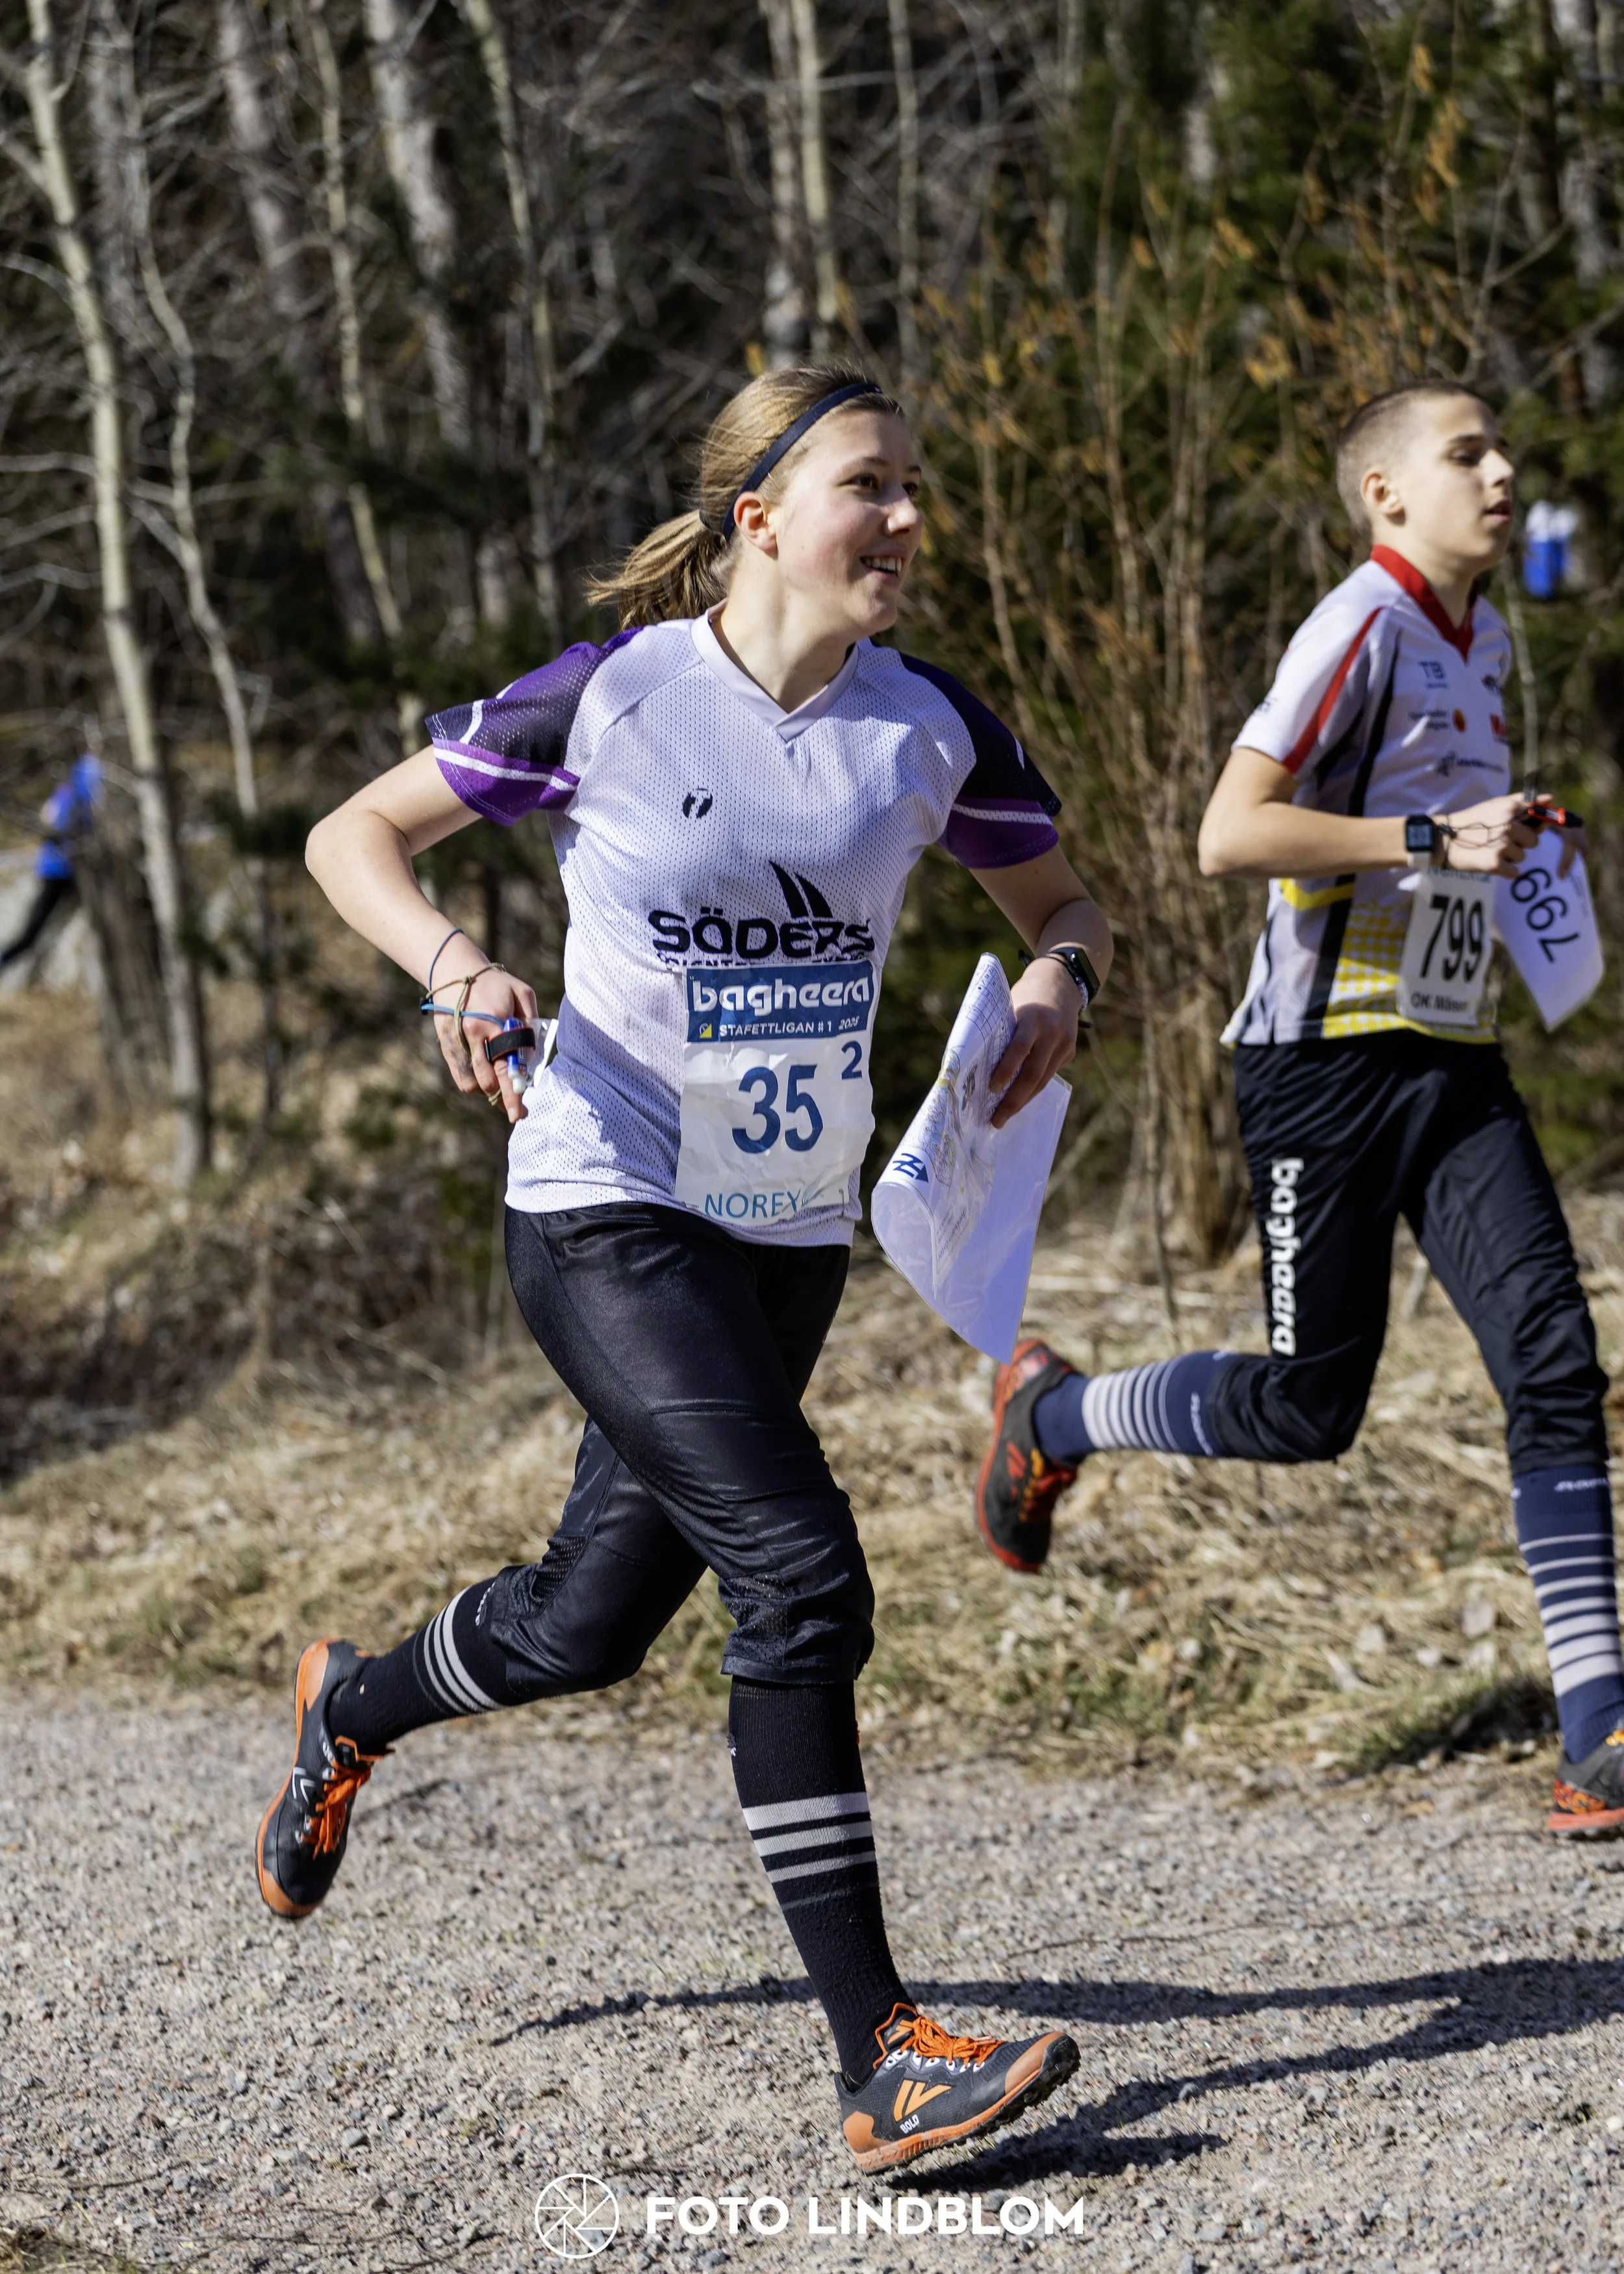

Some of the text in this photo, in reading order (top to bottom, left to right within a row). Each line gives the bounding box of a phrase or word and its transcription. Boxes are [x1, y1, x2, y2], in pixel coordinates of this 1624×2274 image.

[648, 906, 875, 959] SÖDERS
[1420, 894, 1484, 982] 799
[1510, 867, 1580, 963] 799
[690, 977, 869, 1016] bagheera
[719, 1022, 814, 1037] STAFETTLIGAN
[841, 1040, 863, 1080] 2
[731, 1064, 823, 1153] 35
[1266, 1157, 1304, 1356] bagheera
[900, 2114, 919, 2134] BOLD
